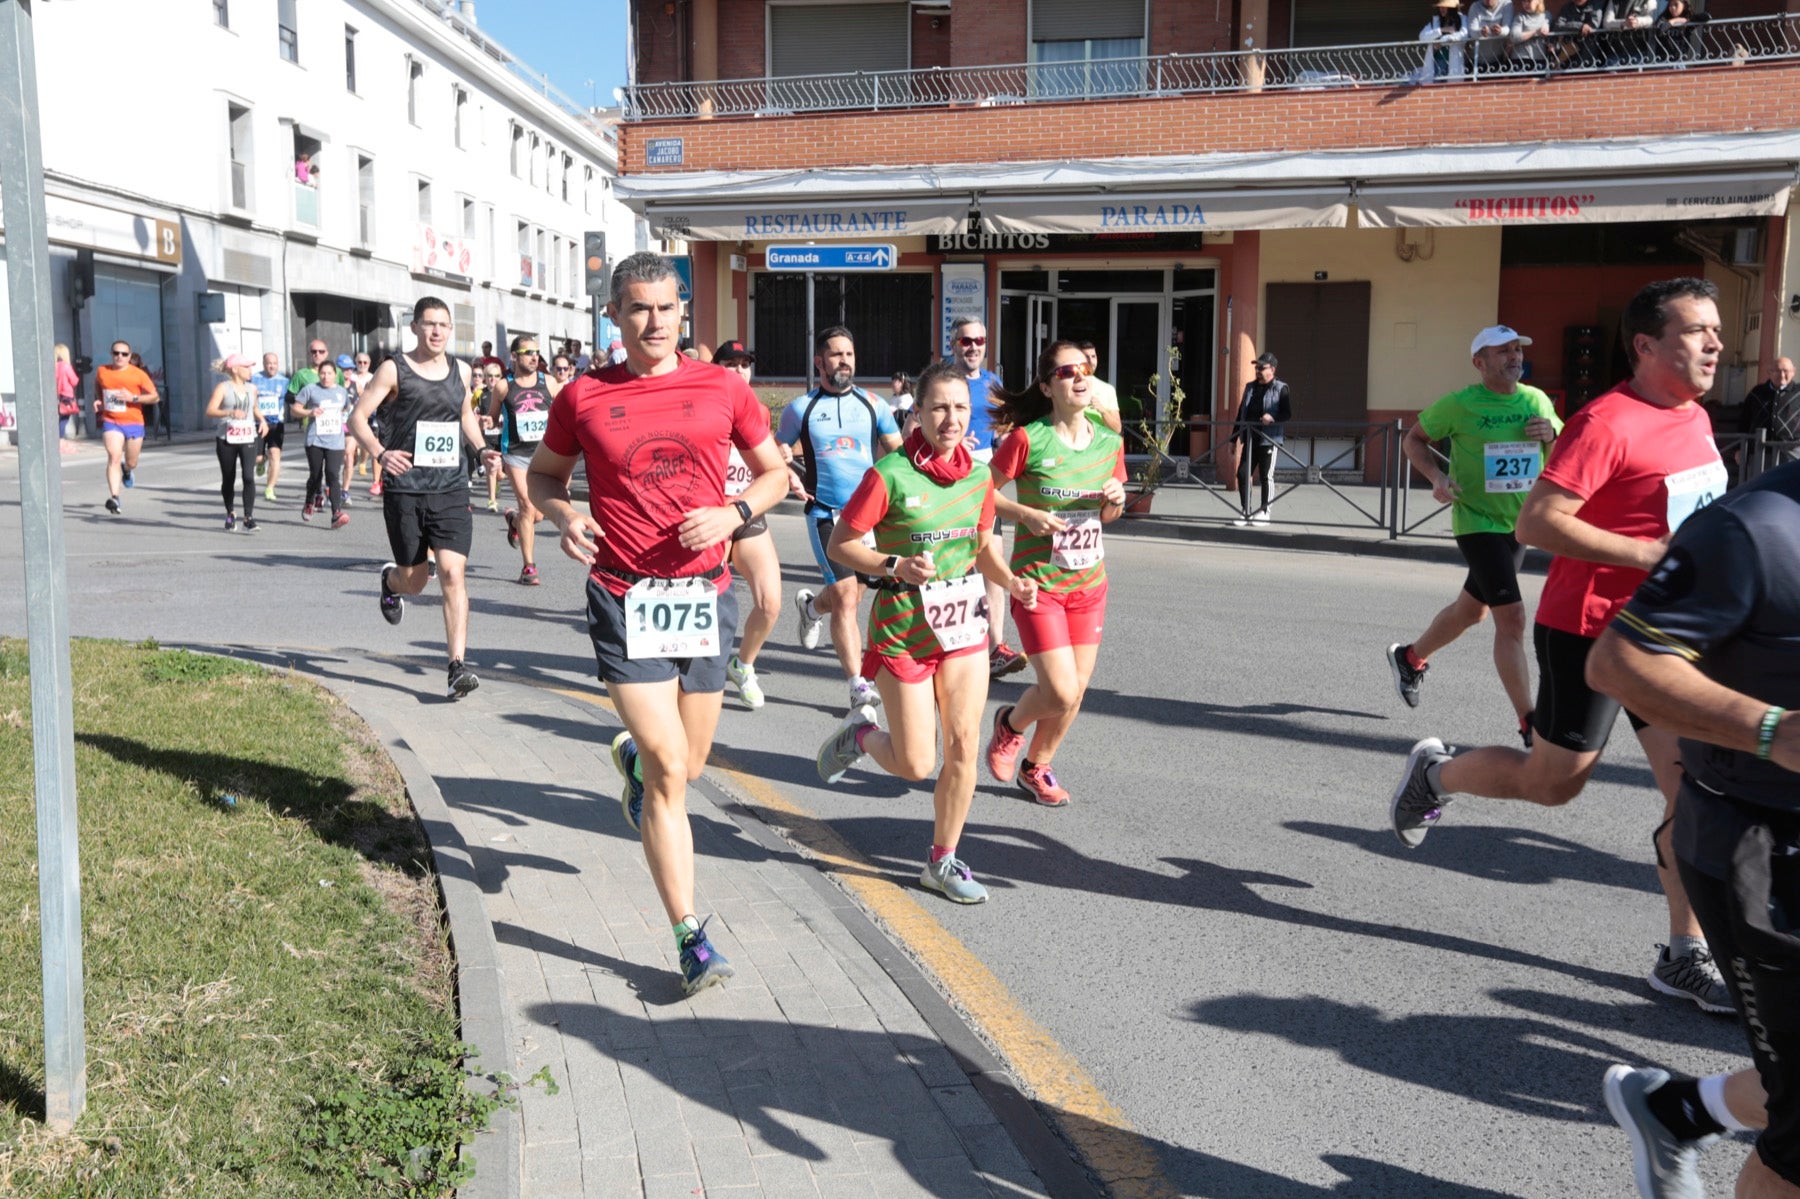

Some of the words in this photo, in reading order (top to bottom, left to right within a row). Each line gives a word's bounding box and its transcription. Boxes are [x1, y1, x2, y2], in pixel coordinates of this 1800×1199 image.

[1682, 197, 1725, 206] CERVEZAS
[745, 211, 908, 235] RESTAURANTE
[1101, 204, 1207, 226] PARADA
[163, 228, 176, 255] B
[938, 233, 1050, 250] BICHITOS
[770, 253, 820, 263] Granada
[227, 426, 252, 436] 2213
[425, 436, 454, 452] 629
[1495, 458, 1532, 477] 237
[911, 527, 976, 544] GRUYSER
[1057, 528, 1100, 551] 2227
[634, 603, 713, 632] 1075
